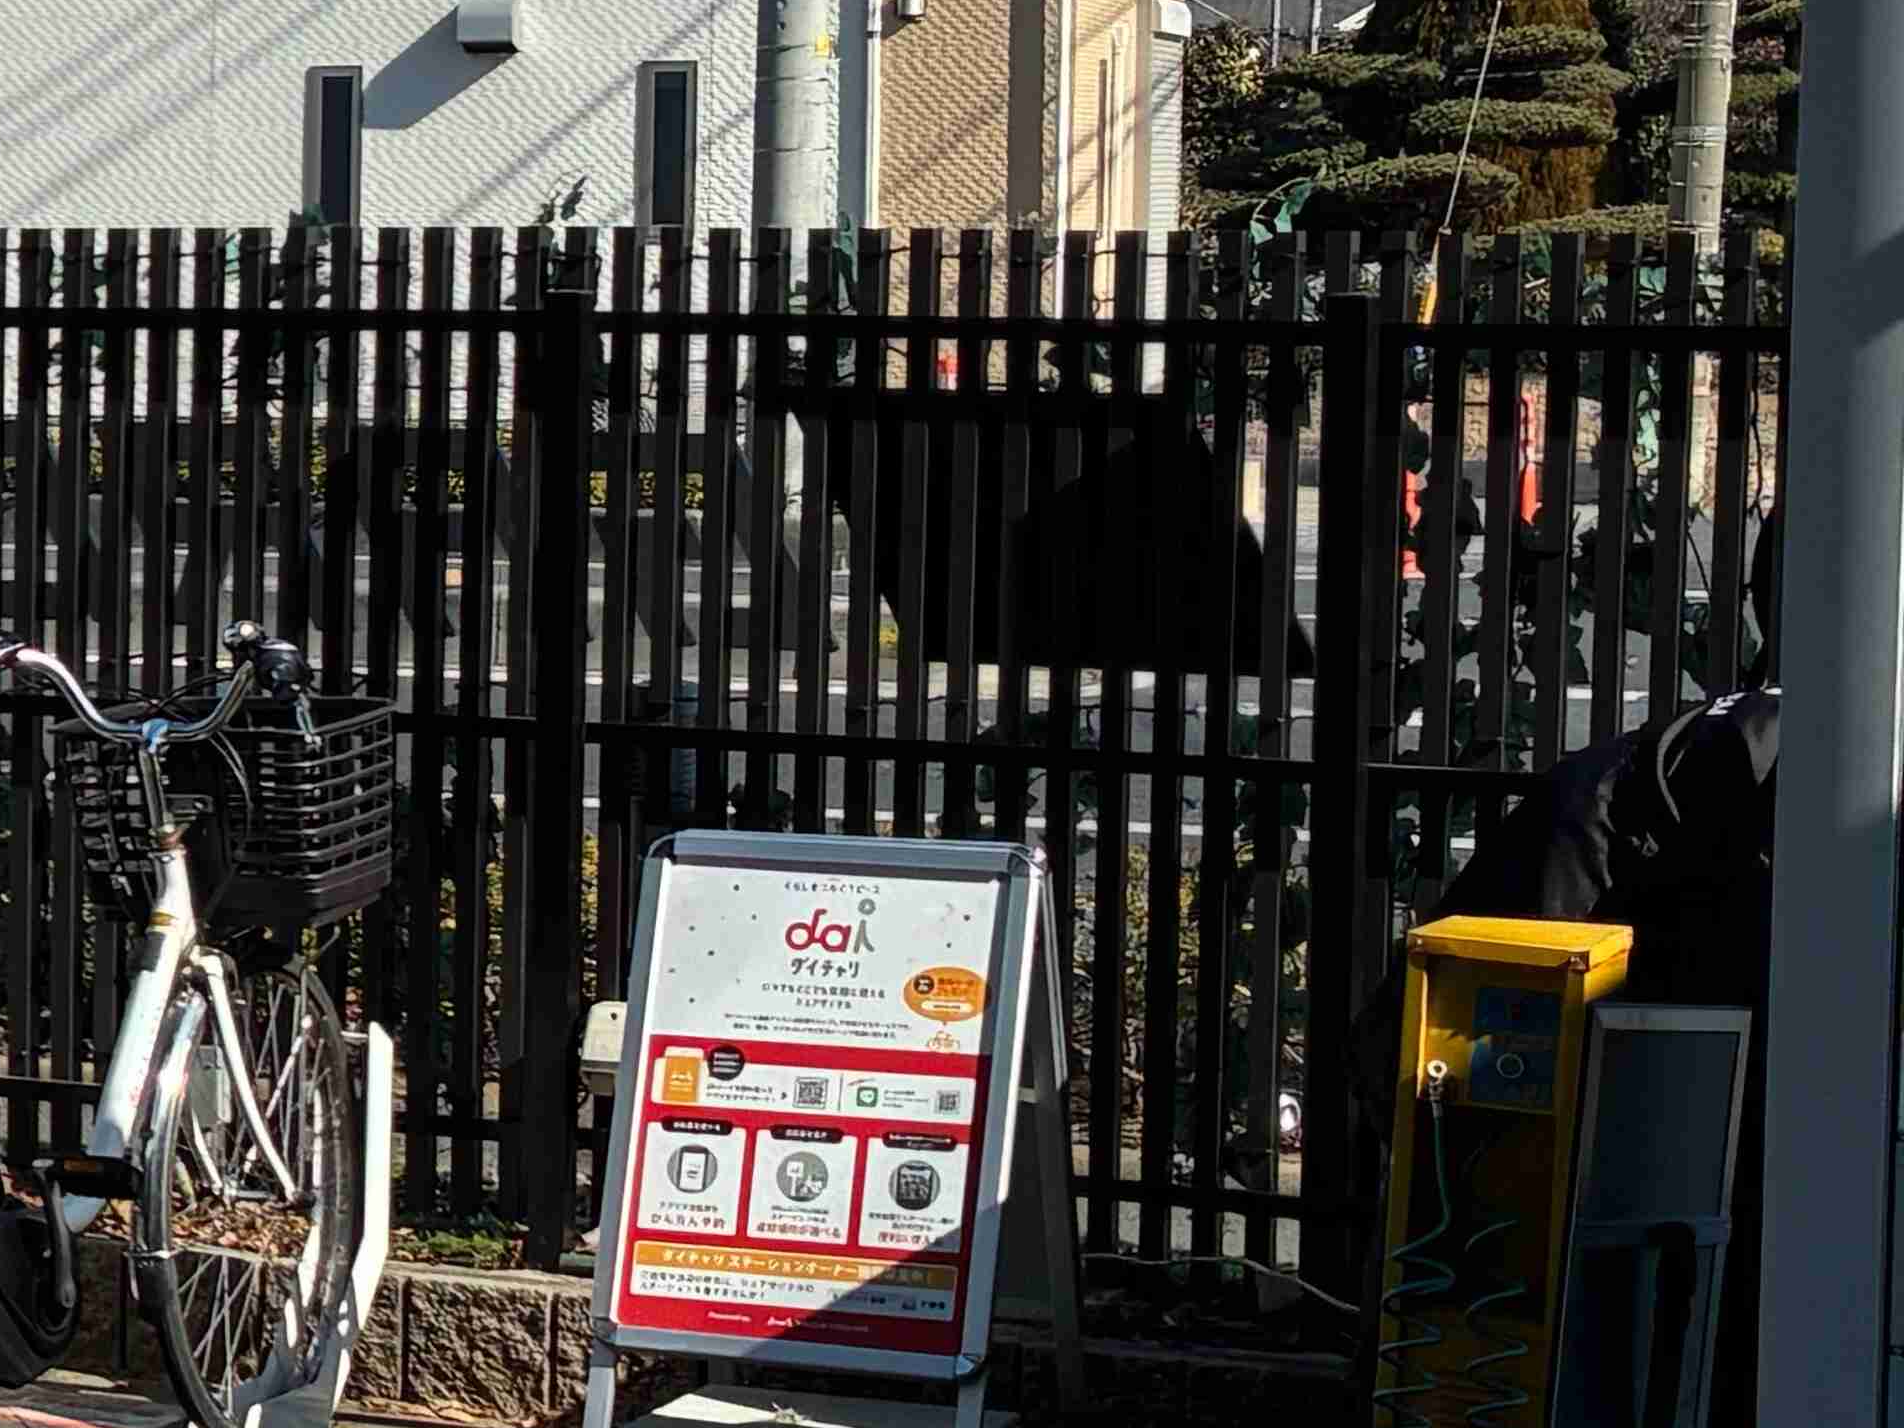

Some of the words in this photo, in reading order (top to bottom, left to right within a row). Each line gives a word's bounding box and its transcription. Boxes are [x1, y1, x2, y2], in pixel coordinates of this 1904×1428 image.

[791, 957, 860, 979] ダイチャリ
